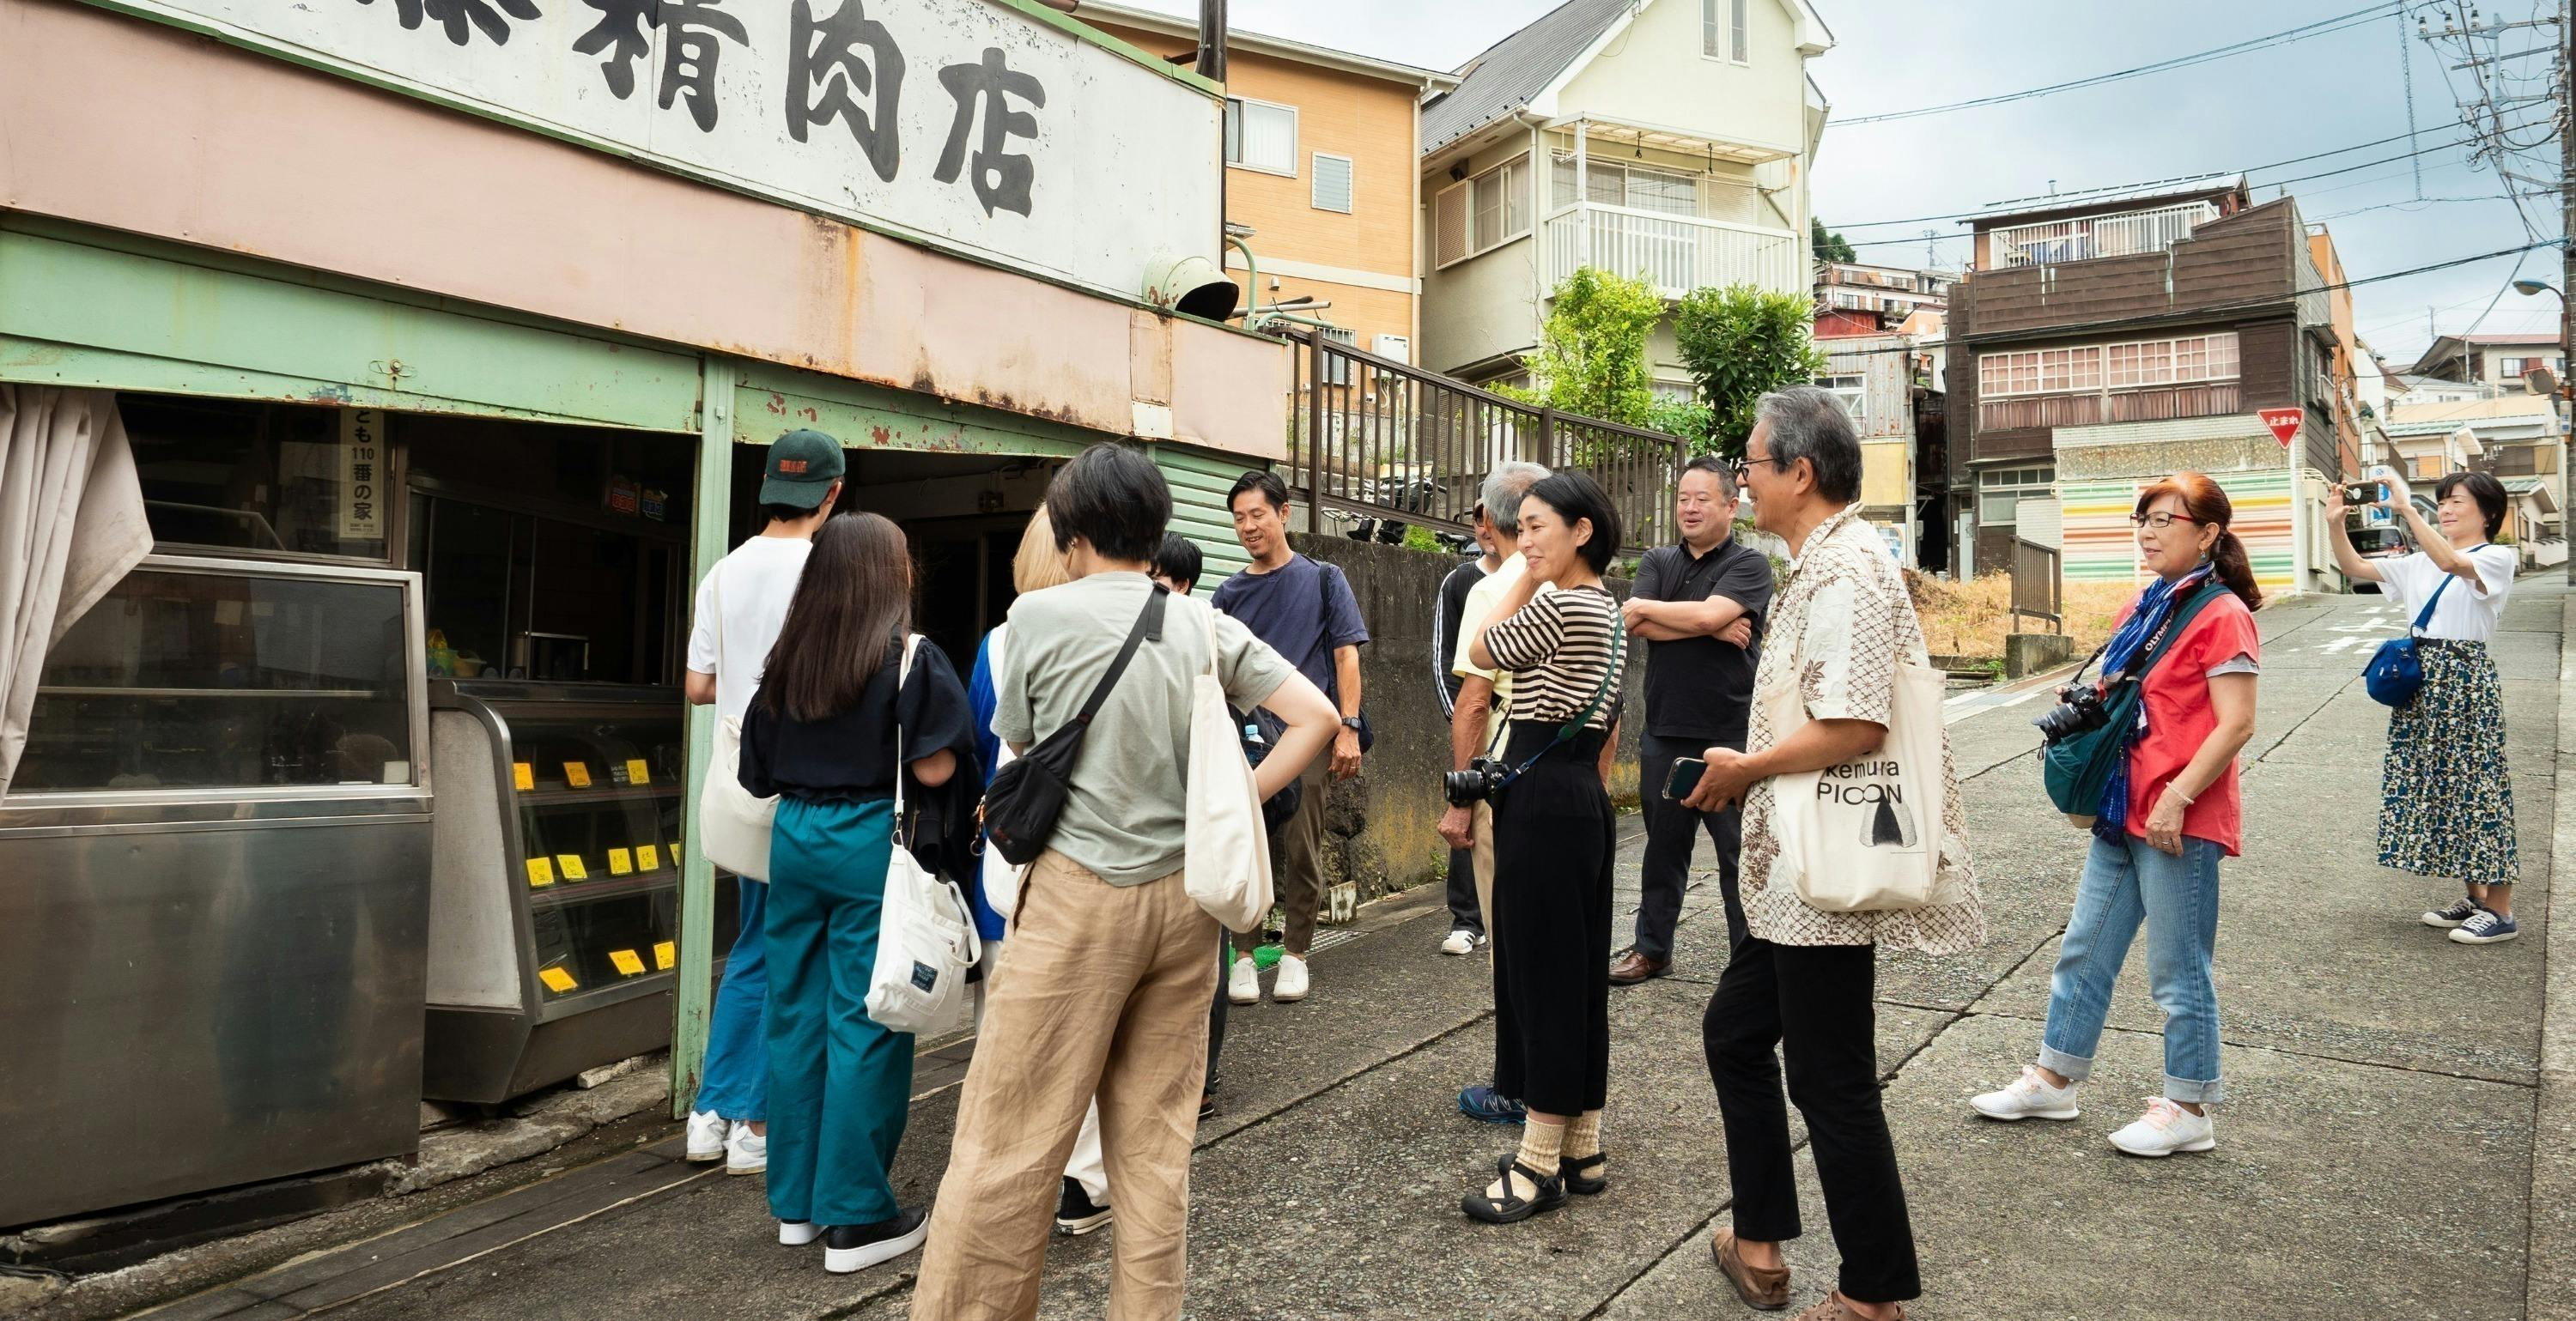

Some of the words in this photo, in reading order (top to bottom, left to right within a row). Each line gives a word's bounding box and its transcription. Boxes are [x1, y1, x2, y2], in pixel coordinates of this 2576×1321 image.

[355, 0, 1047, 218] 精肉店
[2269, 415, 2300, 427] 止まれ
[2145, 609, 2174, 651] OLYMP
